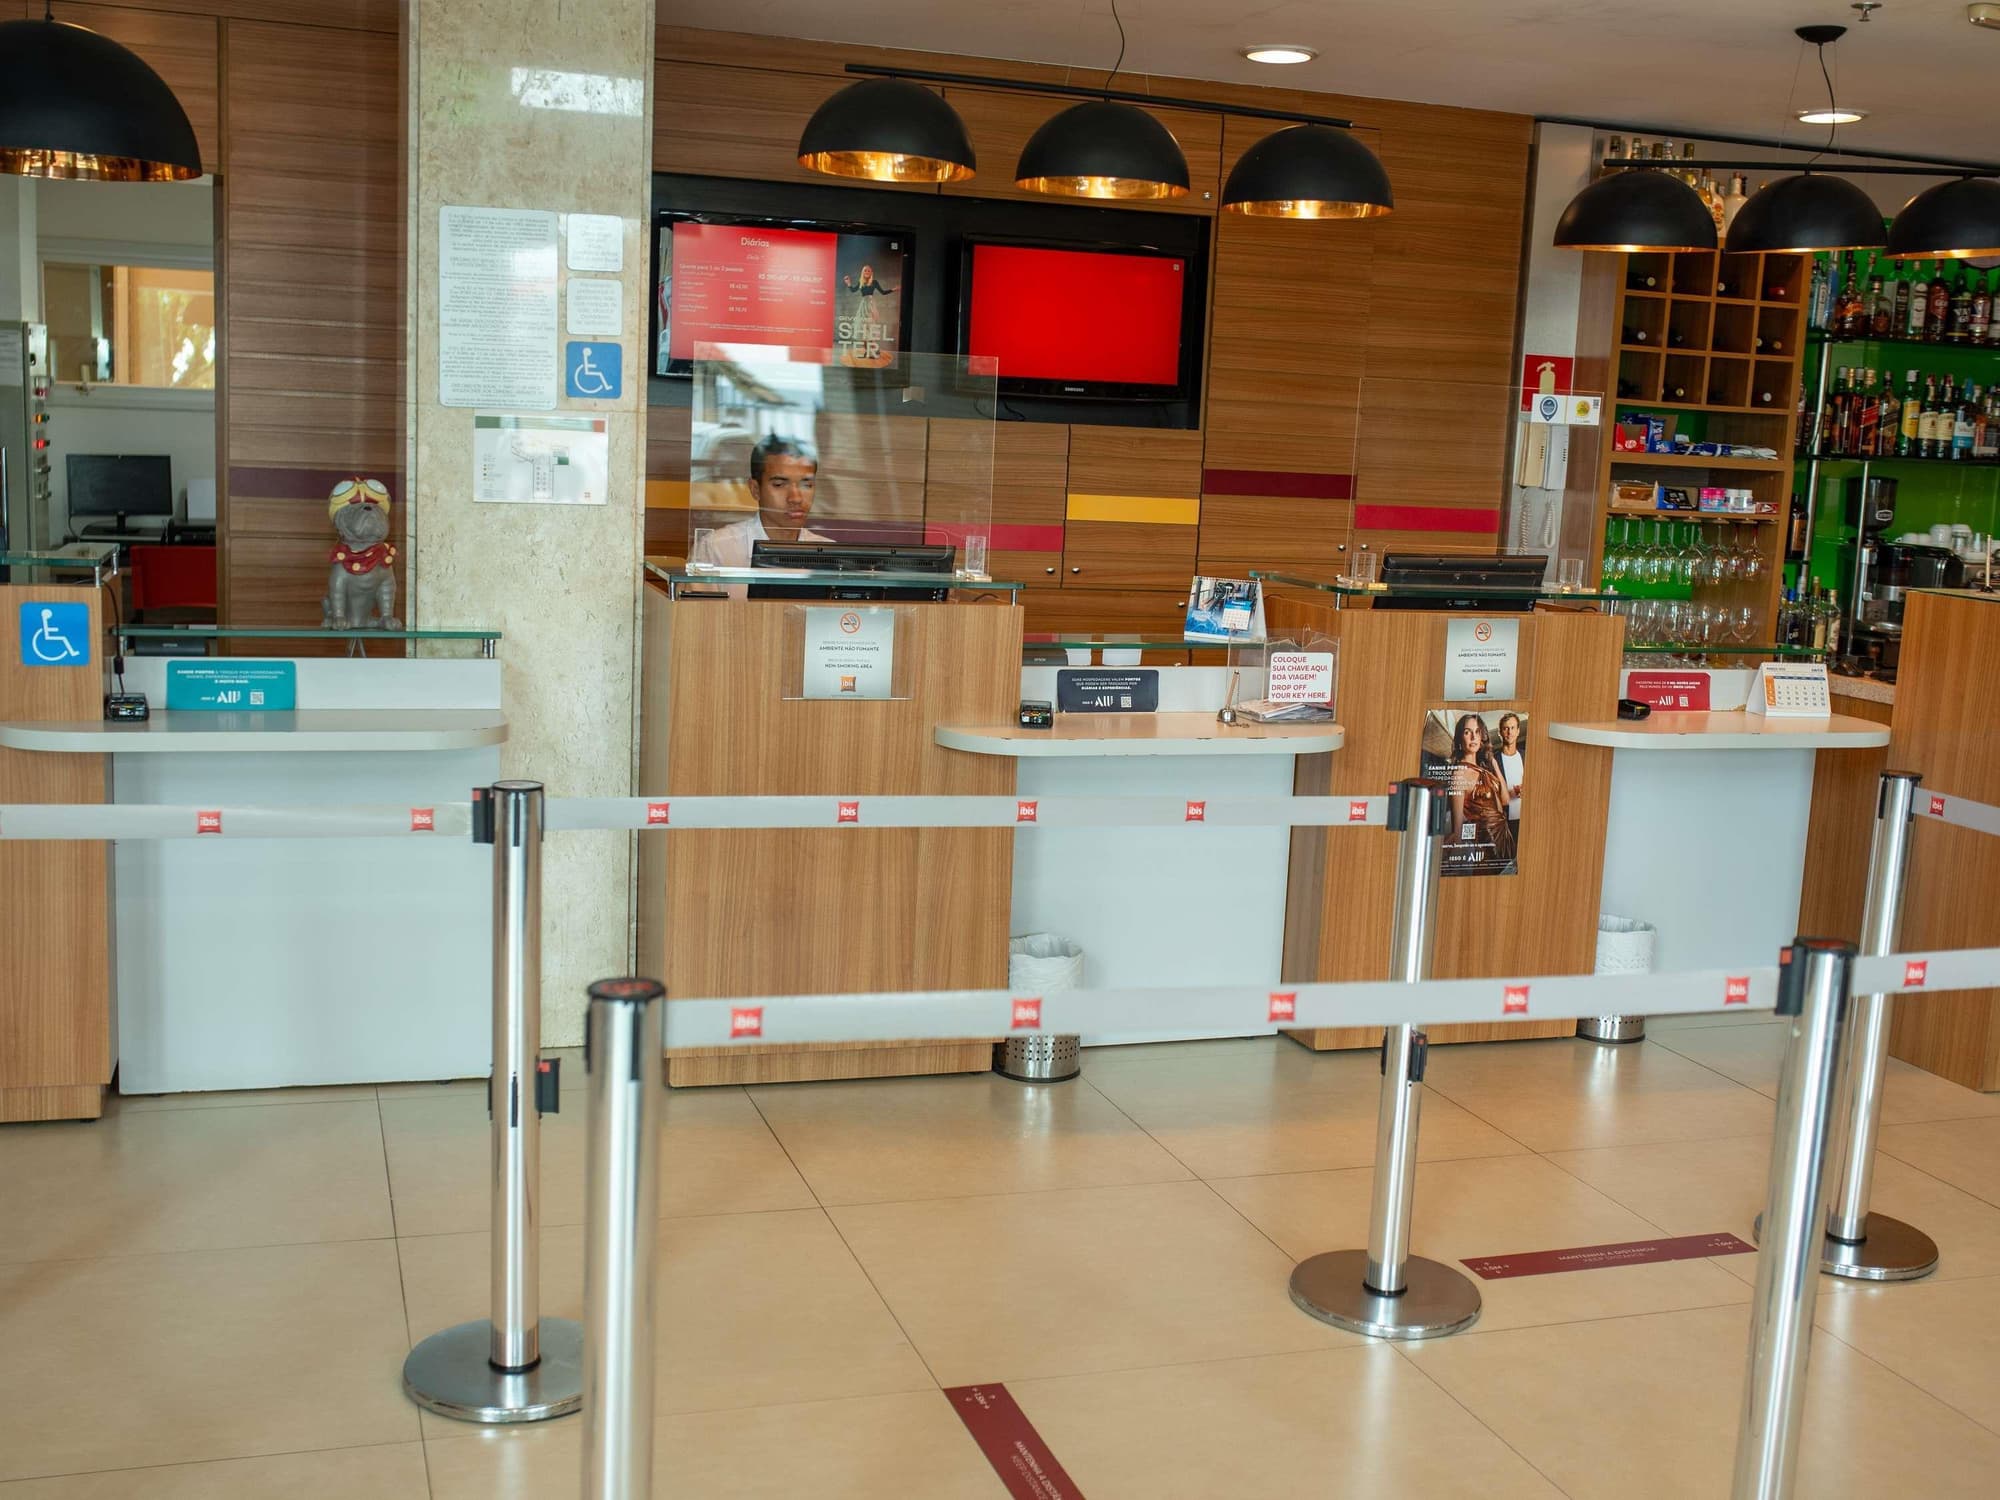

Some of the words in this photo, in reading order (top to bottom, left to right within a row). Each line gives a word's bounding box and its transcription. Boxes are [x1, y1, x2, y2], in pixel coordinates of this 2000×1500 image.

[741, 237, 770, 249] Diárias
[838, 322, 894, 341] SHEL
[838, 341, 880, 359] TER
[1272, 656, 1308, 664] COLOQUE
[650, 808, 667, 818] ibis
[840, 806, 857, 817] ibis
[1019, 806, 1035, 816] ibis
[1189, 806, 1202, 816] ibis
[1351, 806, 1366, 816] ibis
[199, 816, 218, 827] ibis
[413, 814, 432, 824] ibis
[1557, 1252, 1606, 1260] MANTENHA
[1614, 1247, 1657, 1255] DISTÂNCIA
